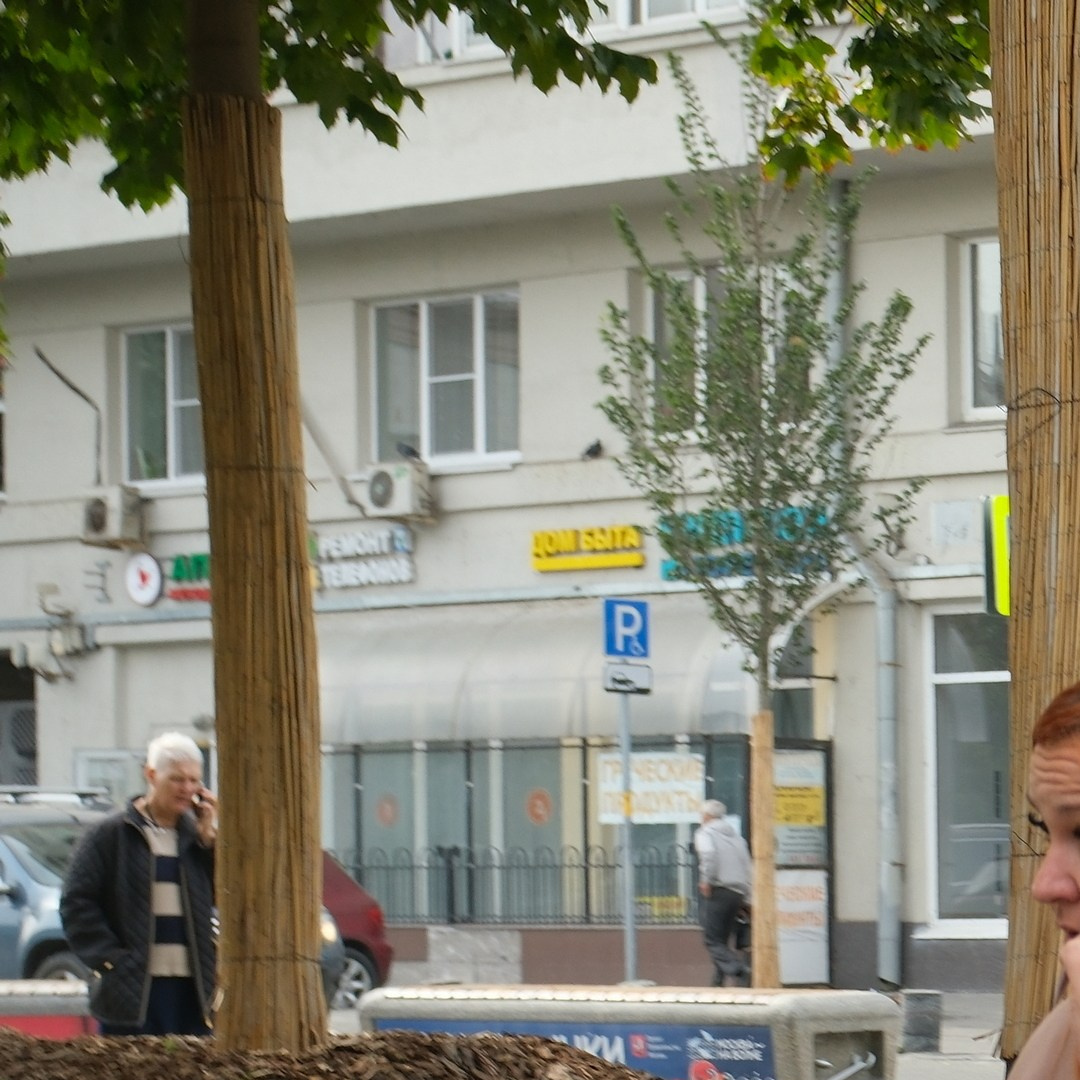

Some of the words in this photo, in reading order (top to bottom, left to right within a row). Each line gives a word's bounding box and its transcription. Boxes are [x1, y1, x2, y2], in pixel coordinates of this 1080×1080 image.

[318, 530, 391, 559] РЕМОНТ
[532, 530, 579, 558] ДОМ
[580, 525, 641, 551] БЫТА
[602, 759, 704, 783] ГРЧЕСКИЕ
